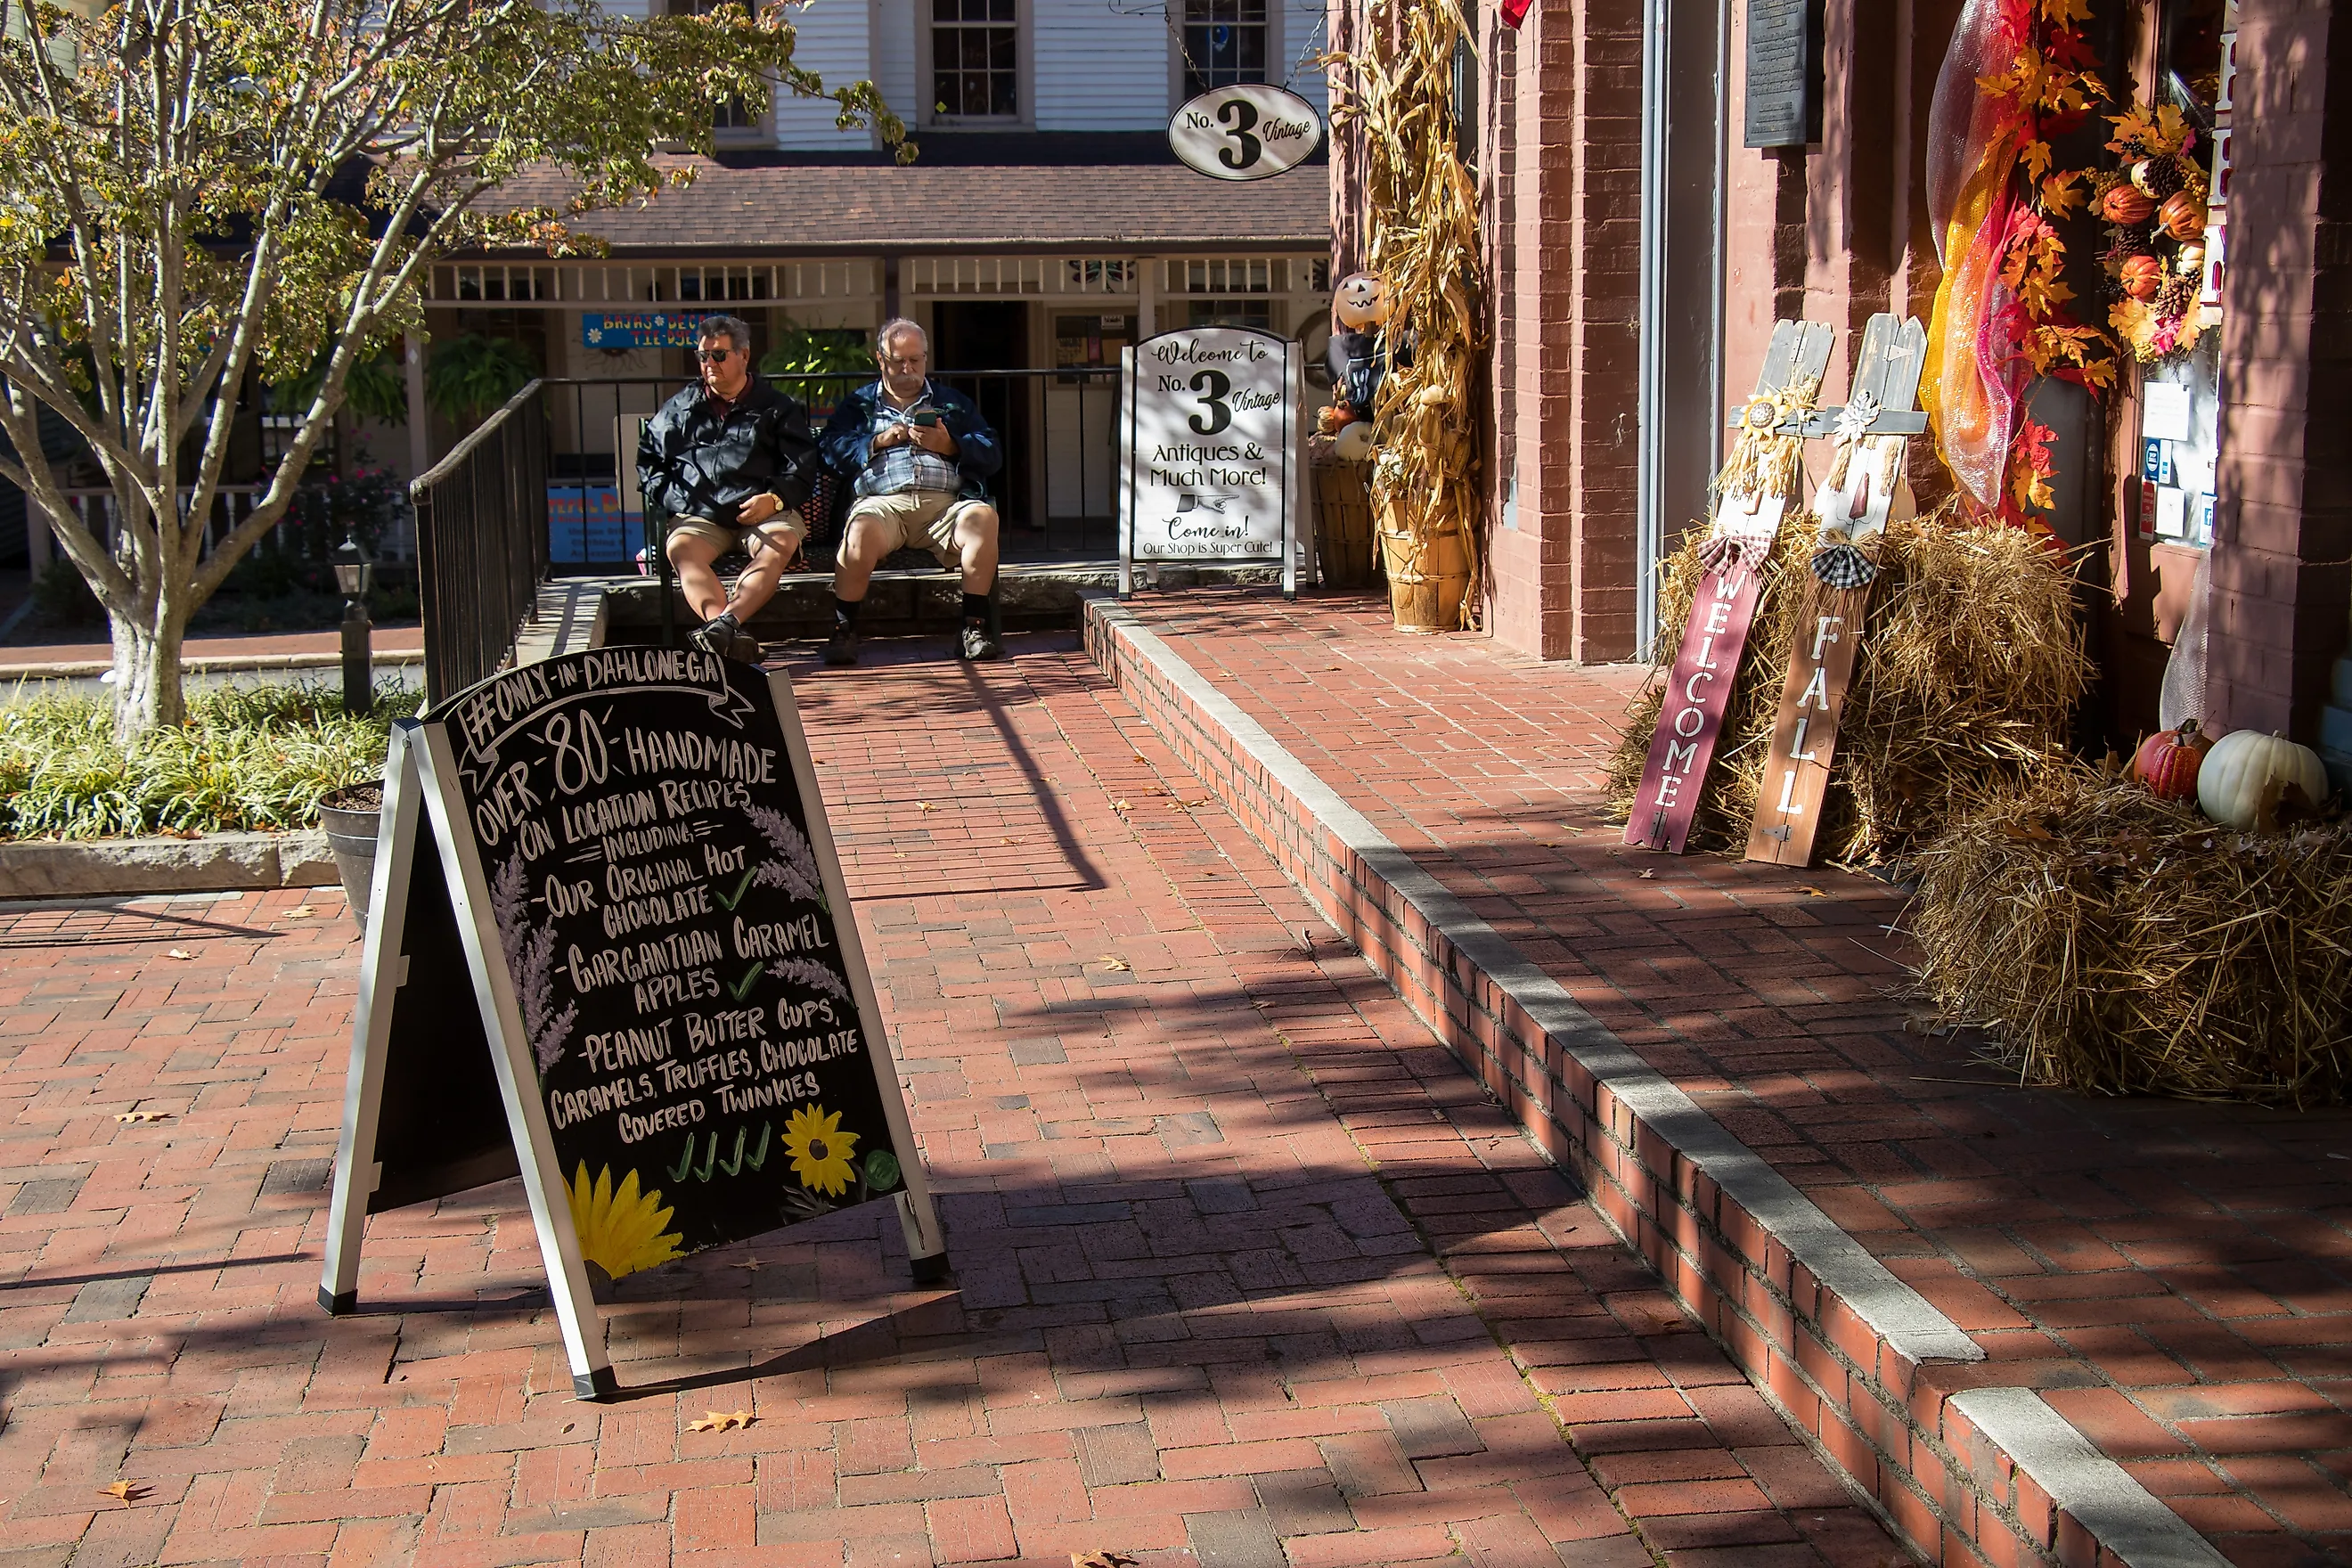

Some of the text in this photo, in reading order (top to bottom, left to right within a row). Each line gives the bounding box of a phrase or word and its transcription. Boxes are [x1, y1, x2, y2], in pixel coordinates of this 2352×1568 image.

[1186, 99, 1311, 169] No. 3 Vintage
[603, 314, 652, 330] BAJAS
[1151, 338, 1269, 365] Welcome to
[1158, 370, 1282, 436] No. 3 Vintage
[1150, 467, 1267, 486] Much More!
[1153, 442, 1264, 465] Antiques &
[1143, 541, 1272, 556] Our Shop is Super Cute!
[1162, 515, 1249, 540] Come in!
[1654, 570, 1748, 807] WELCOME
[1776, 616, 1845, 815] FALL
[475, 761, 542, 845] OVER
[625, 727, 777, 784] HANDMADE
[520, 780, 751, 861] ON LOCATION RECIPES
[602, 821, 694, 862] INCLUDING
[606, 858, 703, 902] ORIGINAL
[704, 844, 746, 876] HOT
[603, 884, 714, 939] CHOCOLATE
[733, 913, 829, 961] CARAMEL
[634, 968, 721, 1015] APPLES
[683, 1006, 765, 1053] BUTTER
[777, 997, 841, 1027] CUPS,
[551, 1029, 859, 1131] CARAMELS, TRUFFLES, CHOCOLATE
[618, 1071, 821, 1144] COVERED TWINKIES
